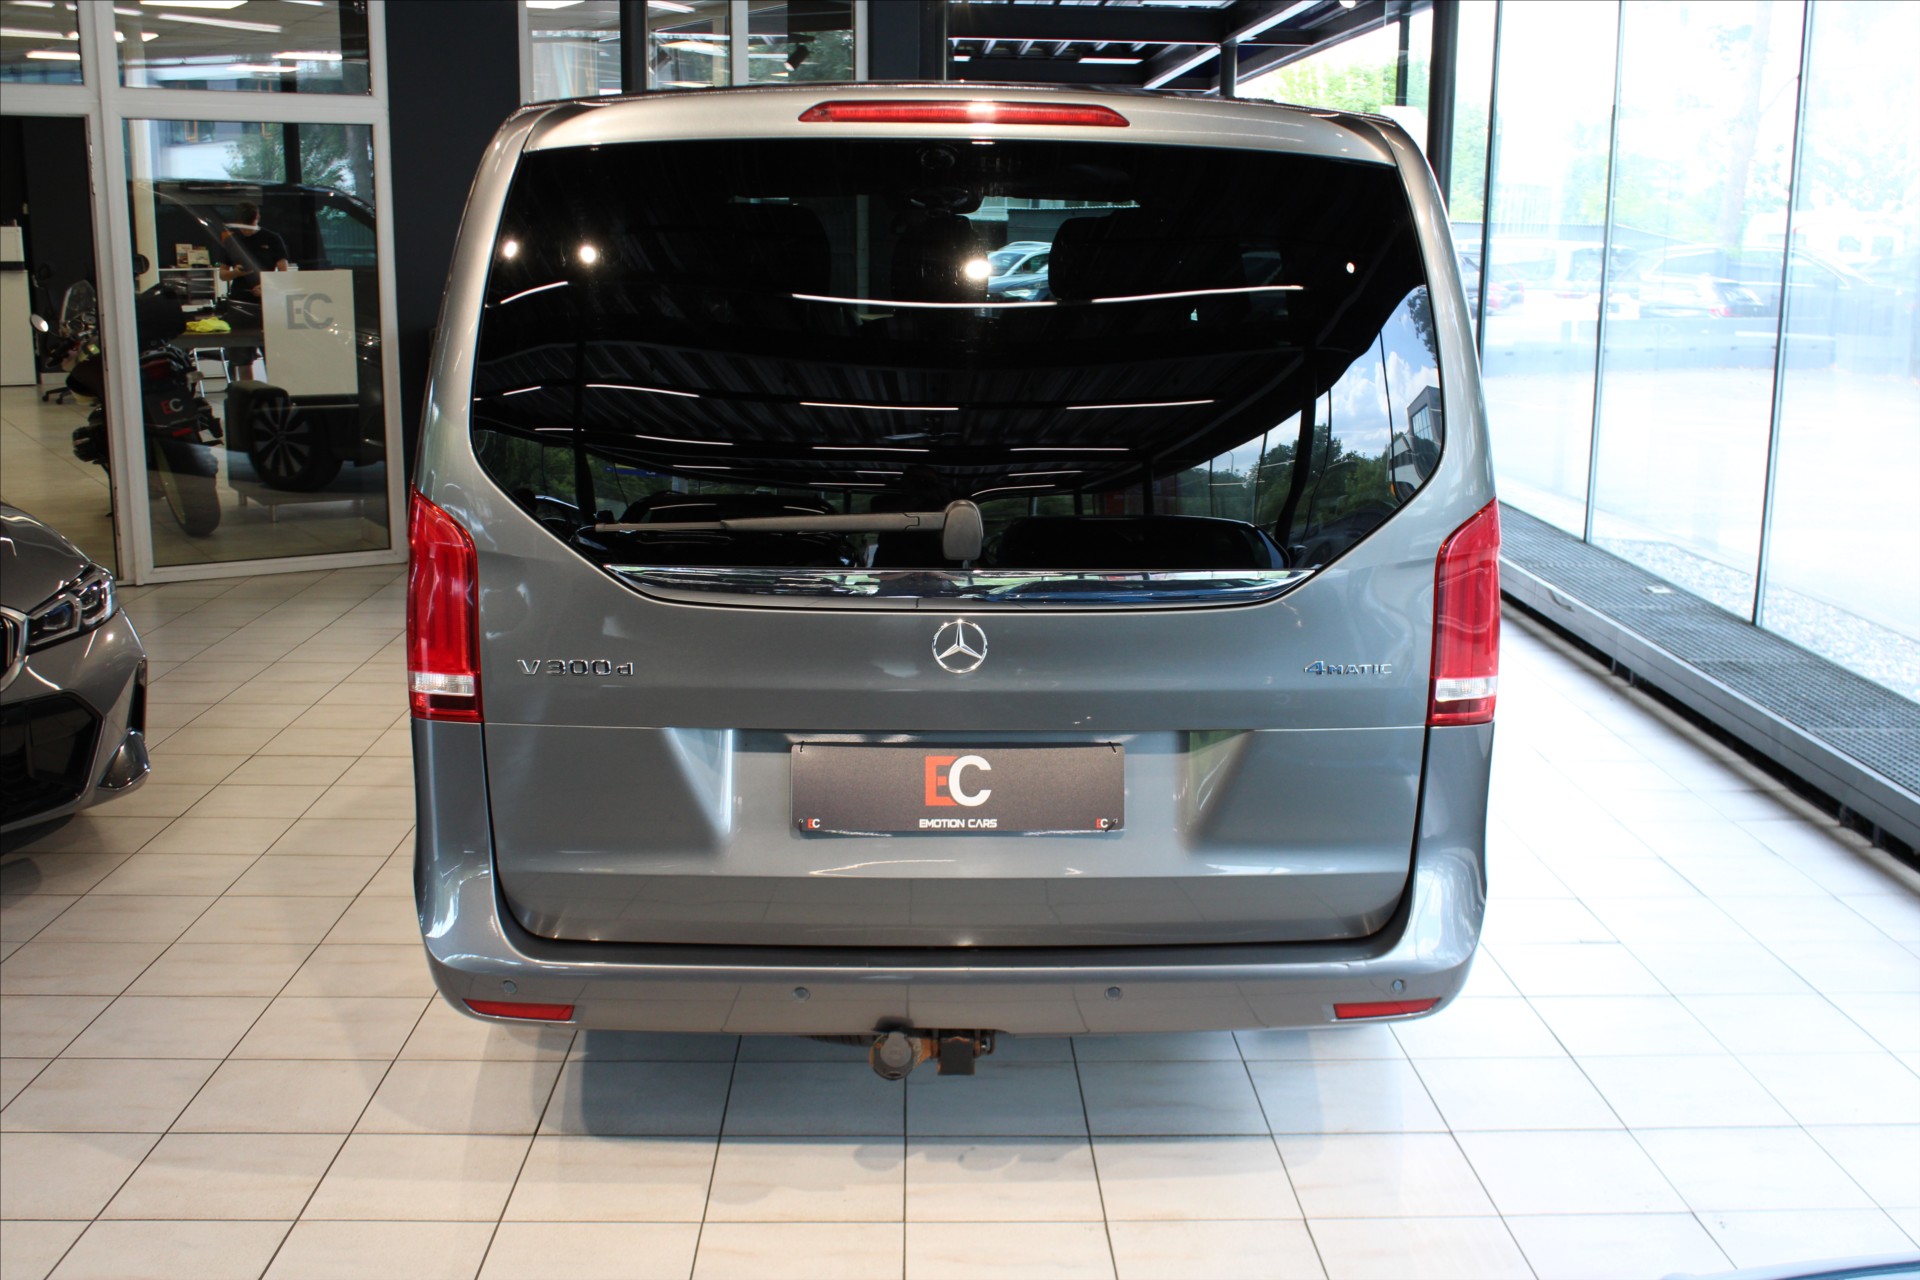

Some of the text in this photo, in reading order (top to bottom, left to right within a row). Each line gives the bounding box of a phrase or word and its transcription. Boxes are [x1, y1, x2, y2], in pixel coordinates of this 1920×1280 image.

[286, 293, 333, 330] EC
[1304, 660, 1393, 676] 4MATIC
[924, 754, 992, 807] EC
[807, 818, 821, 829] EC
[919, 818, 998, 829] EMOTION CARS
[1095, 818, 1109, 829] EC
